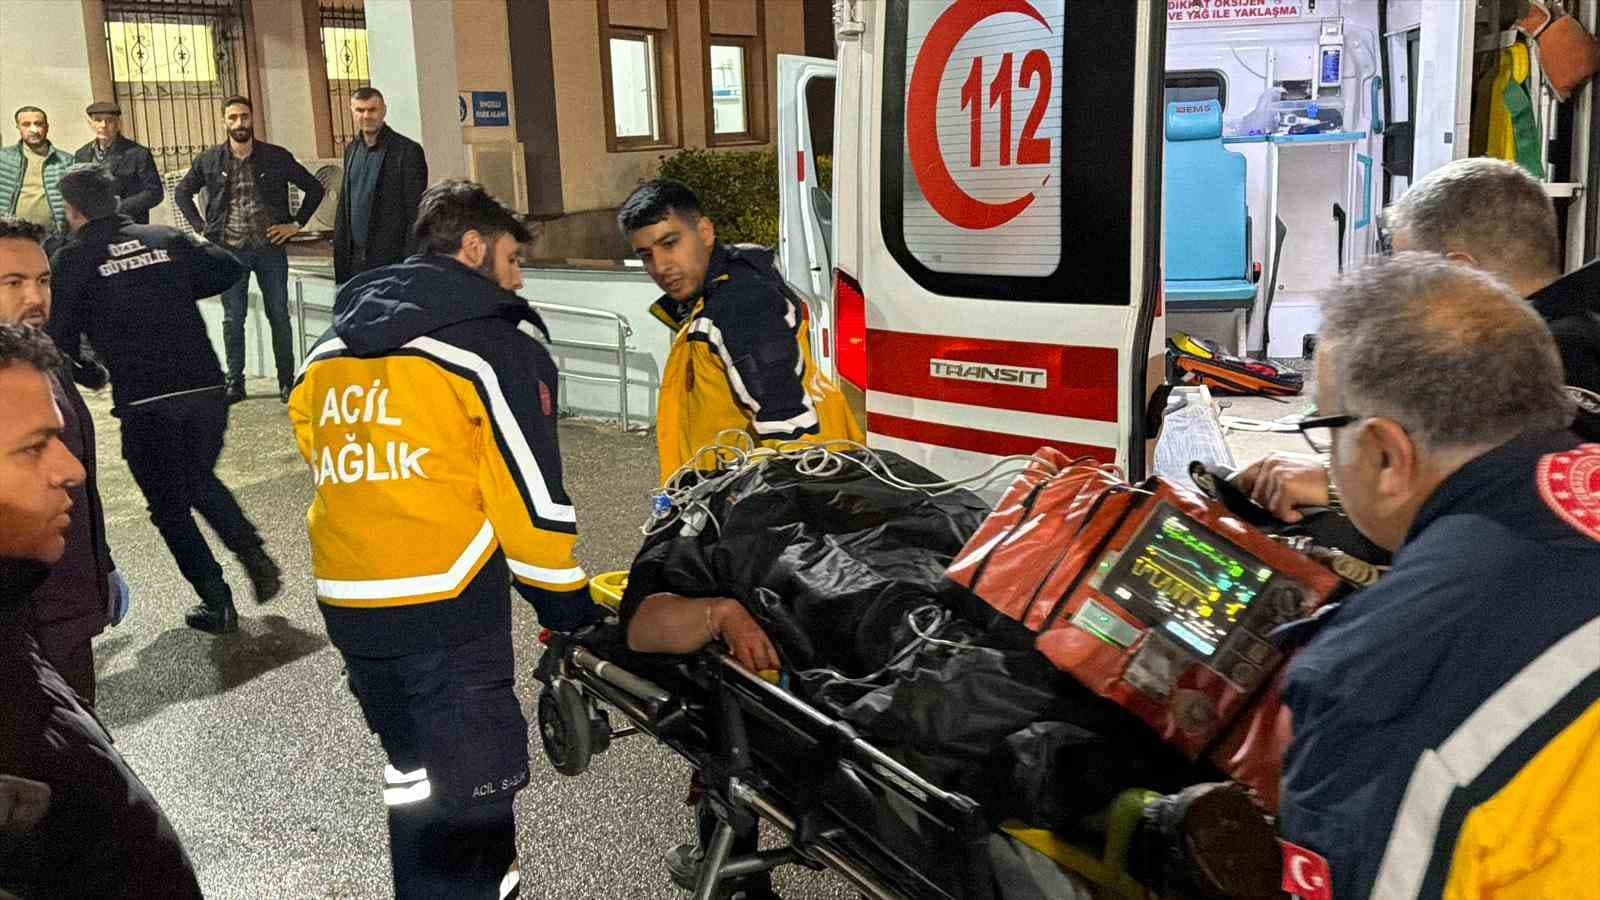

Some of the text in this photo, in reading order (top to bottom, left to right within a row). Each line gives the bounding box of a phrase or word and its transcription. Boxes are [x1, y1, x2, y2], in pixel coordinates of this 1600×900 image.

[1168, 11, 1183, 20] VE
[1234, 6, 1297, 18] YAKLAŞMA
[961, 48, 1053, 167] 112
[108, 240, 147, 257] ÖZEL
[98, 249, 171, 277] GÜVENLİK
[931, 361, 1045, 385] TRANSIT
[319, 378, 402, 427] ACİL
